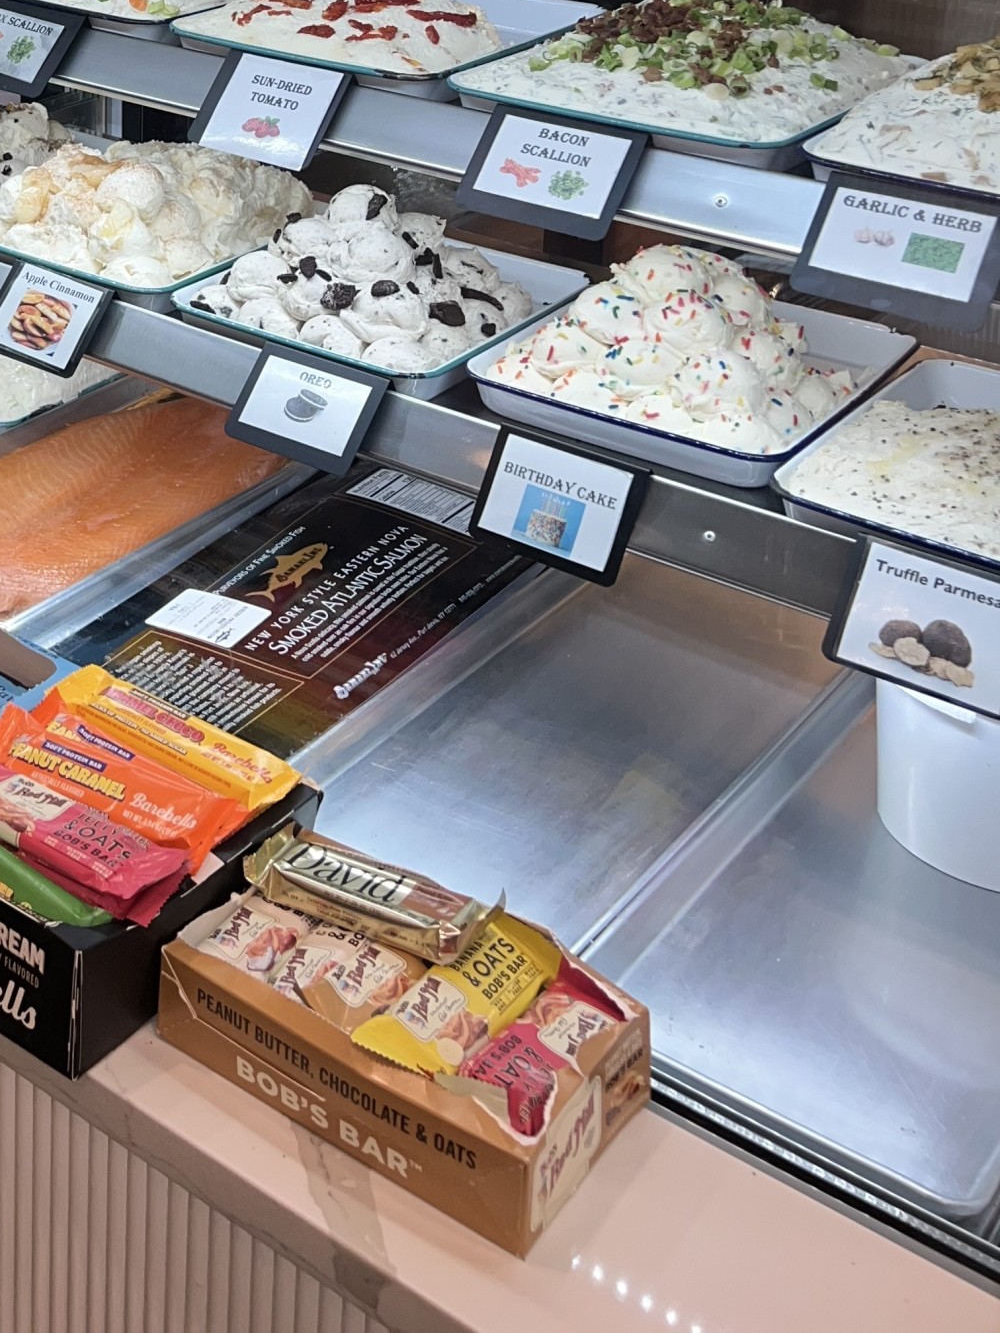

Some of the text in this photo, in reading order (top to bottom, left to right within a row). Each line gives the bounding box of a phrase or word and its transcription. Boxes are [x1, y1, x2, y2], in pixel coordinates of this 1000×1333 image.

[7, 15, 54, 37] SCALLION
[250, 74, 313, 96] SUN-DRIED
[250, 91, 299, 111] TOMATO
[520, 142, 592, 168] SCALLION
[538, 127, 590, 148] BACON
[842, 194, 983, 234] GARLIC & HERB
[22, 271, 96, 304] Apple Cinnamon
[300, 370, 333, 390] OREO
[503, 461, 618, 510] BIRTHDAY CAKE
[245, 561, 257, 574] OF
[253, 552, 270, 567] FINE
[267, 534, 294, 557] SMOKED
[243, 630, 268, 652] NEW
[270, 605, 305, 629] YORK
[305, 578, 337, 605] STYLE
[334, 546, 379, 580] EASTERN
[379, 525, 410, 547] NOVA
[268, 609, 330, 655] SMOKED
[321, 564, 386, 615] ATLANTIC
[373, 533, 429, 571] SALMON
[876, 558, 1000, 608] Truffle Parmesa
[79, 727, 95, 741] SOFT
[93, 734, 119, 753] PROTEIN
[117, 747, 131, 759] BAR
[155, 711, 206, 743] CHOCO
[44, 741, 103, 770] SOFT PROTEIN BAR
[58, 760, 127, 802] CARAMEL
[129, 792, 197, 830] Barebells
[53, 829, 91, 851] BOB'S
[63, 819, 77, 830] &
[77, 826, 133, 860] OATS
[283, 843, 408, 903] David
[4, 956, 40, 989] FLAVORED
[451, 940, 484, 972] BANANA
[462, 937, 516, 988] & OATS
[481, 954, 529, 1000] BOB'S BAR
[196, 987, 478, 1170] PEANUT BUTTER, CHOCOLATE & OATS
[235, 1055, 329, 1130] BOB'S
